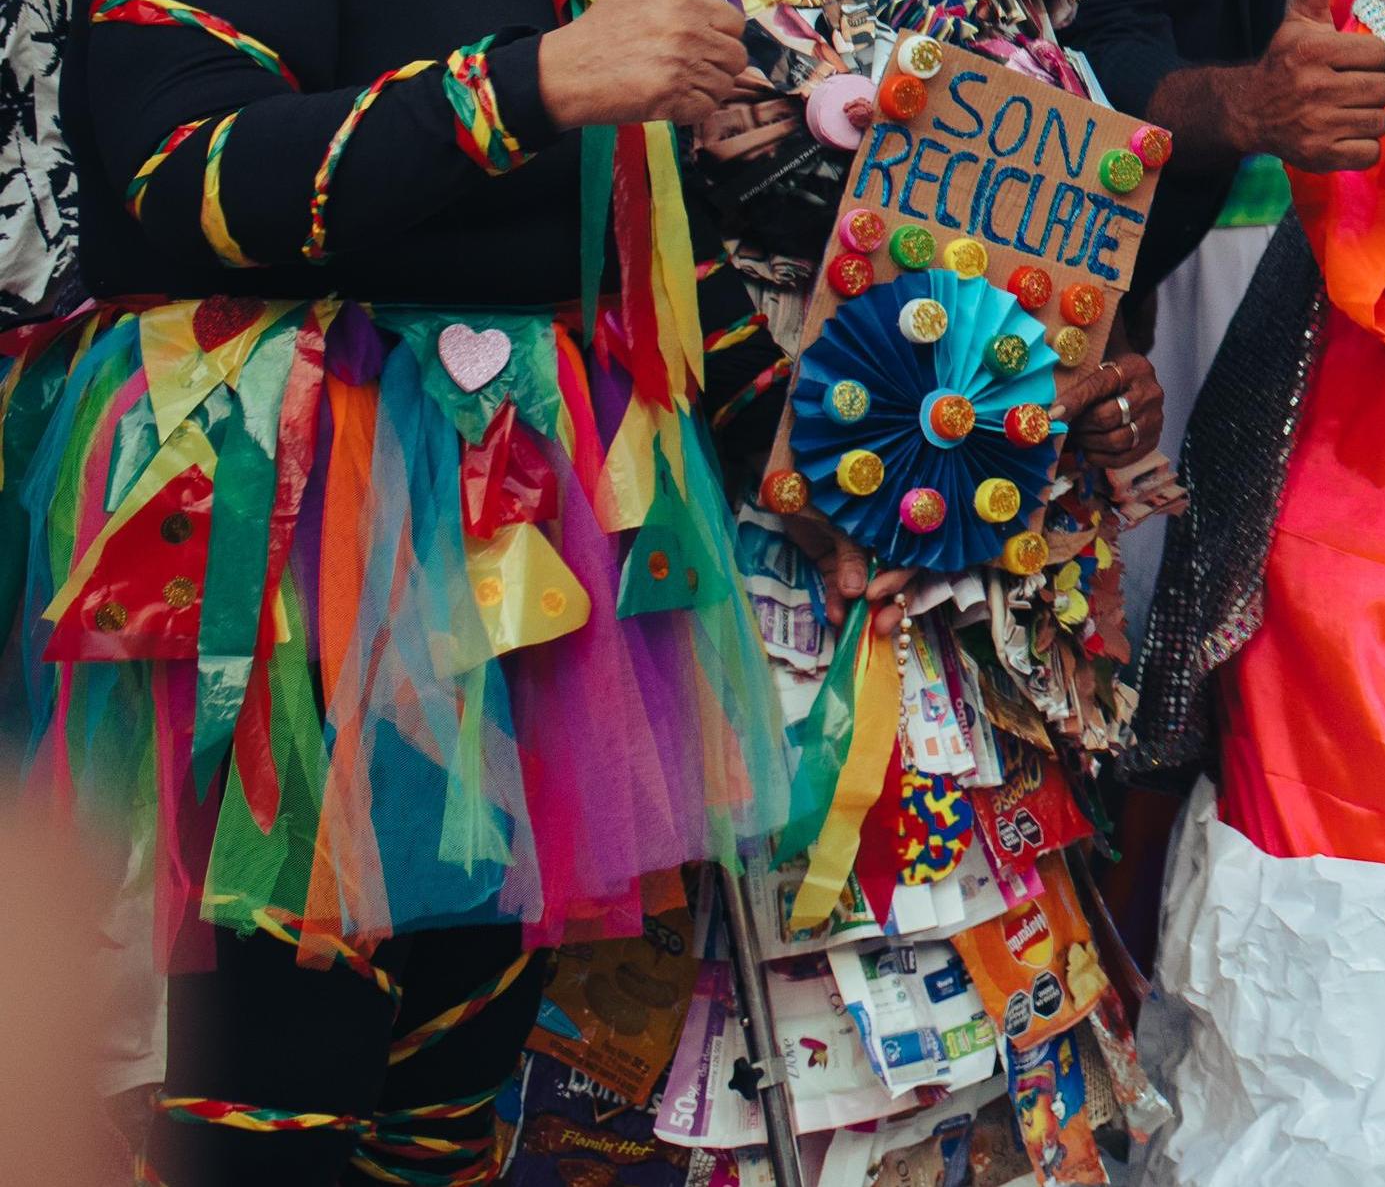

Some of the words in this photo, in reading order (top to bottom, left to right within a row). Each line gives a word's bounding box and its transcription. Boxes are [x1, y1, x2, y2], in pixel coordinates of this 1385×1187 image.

[932, 71, 1096, 179] SON
[853, 123, 1145, 281] RECICLAJE
[992, 755, 1043, 813] Cheese
[670, 1084, 699, 1131] 50%
[617, 1138, 655, 1157] Hot
